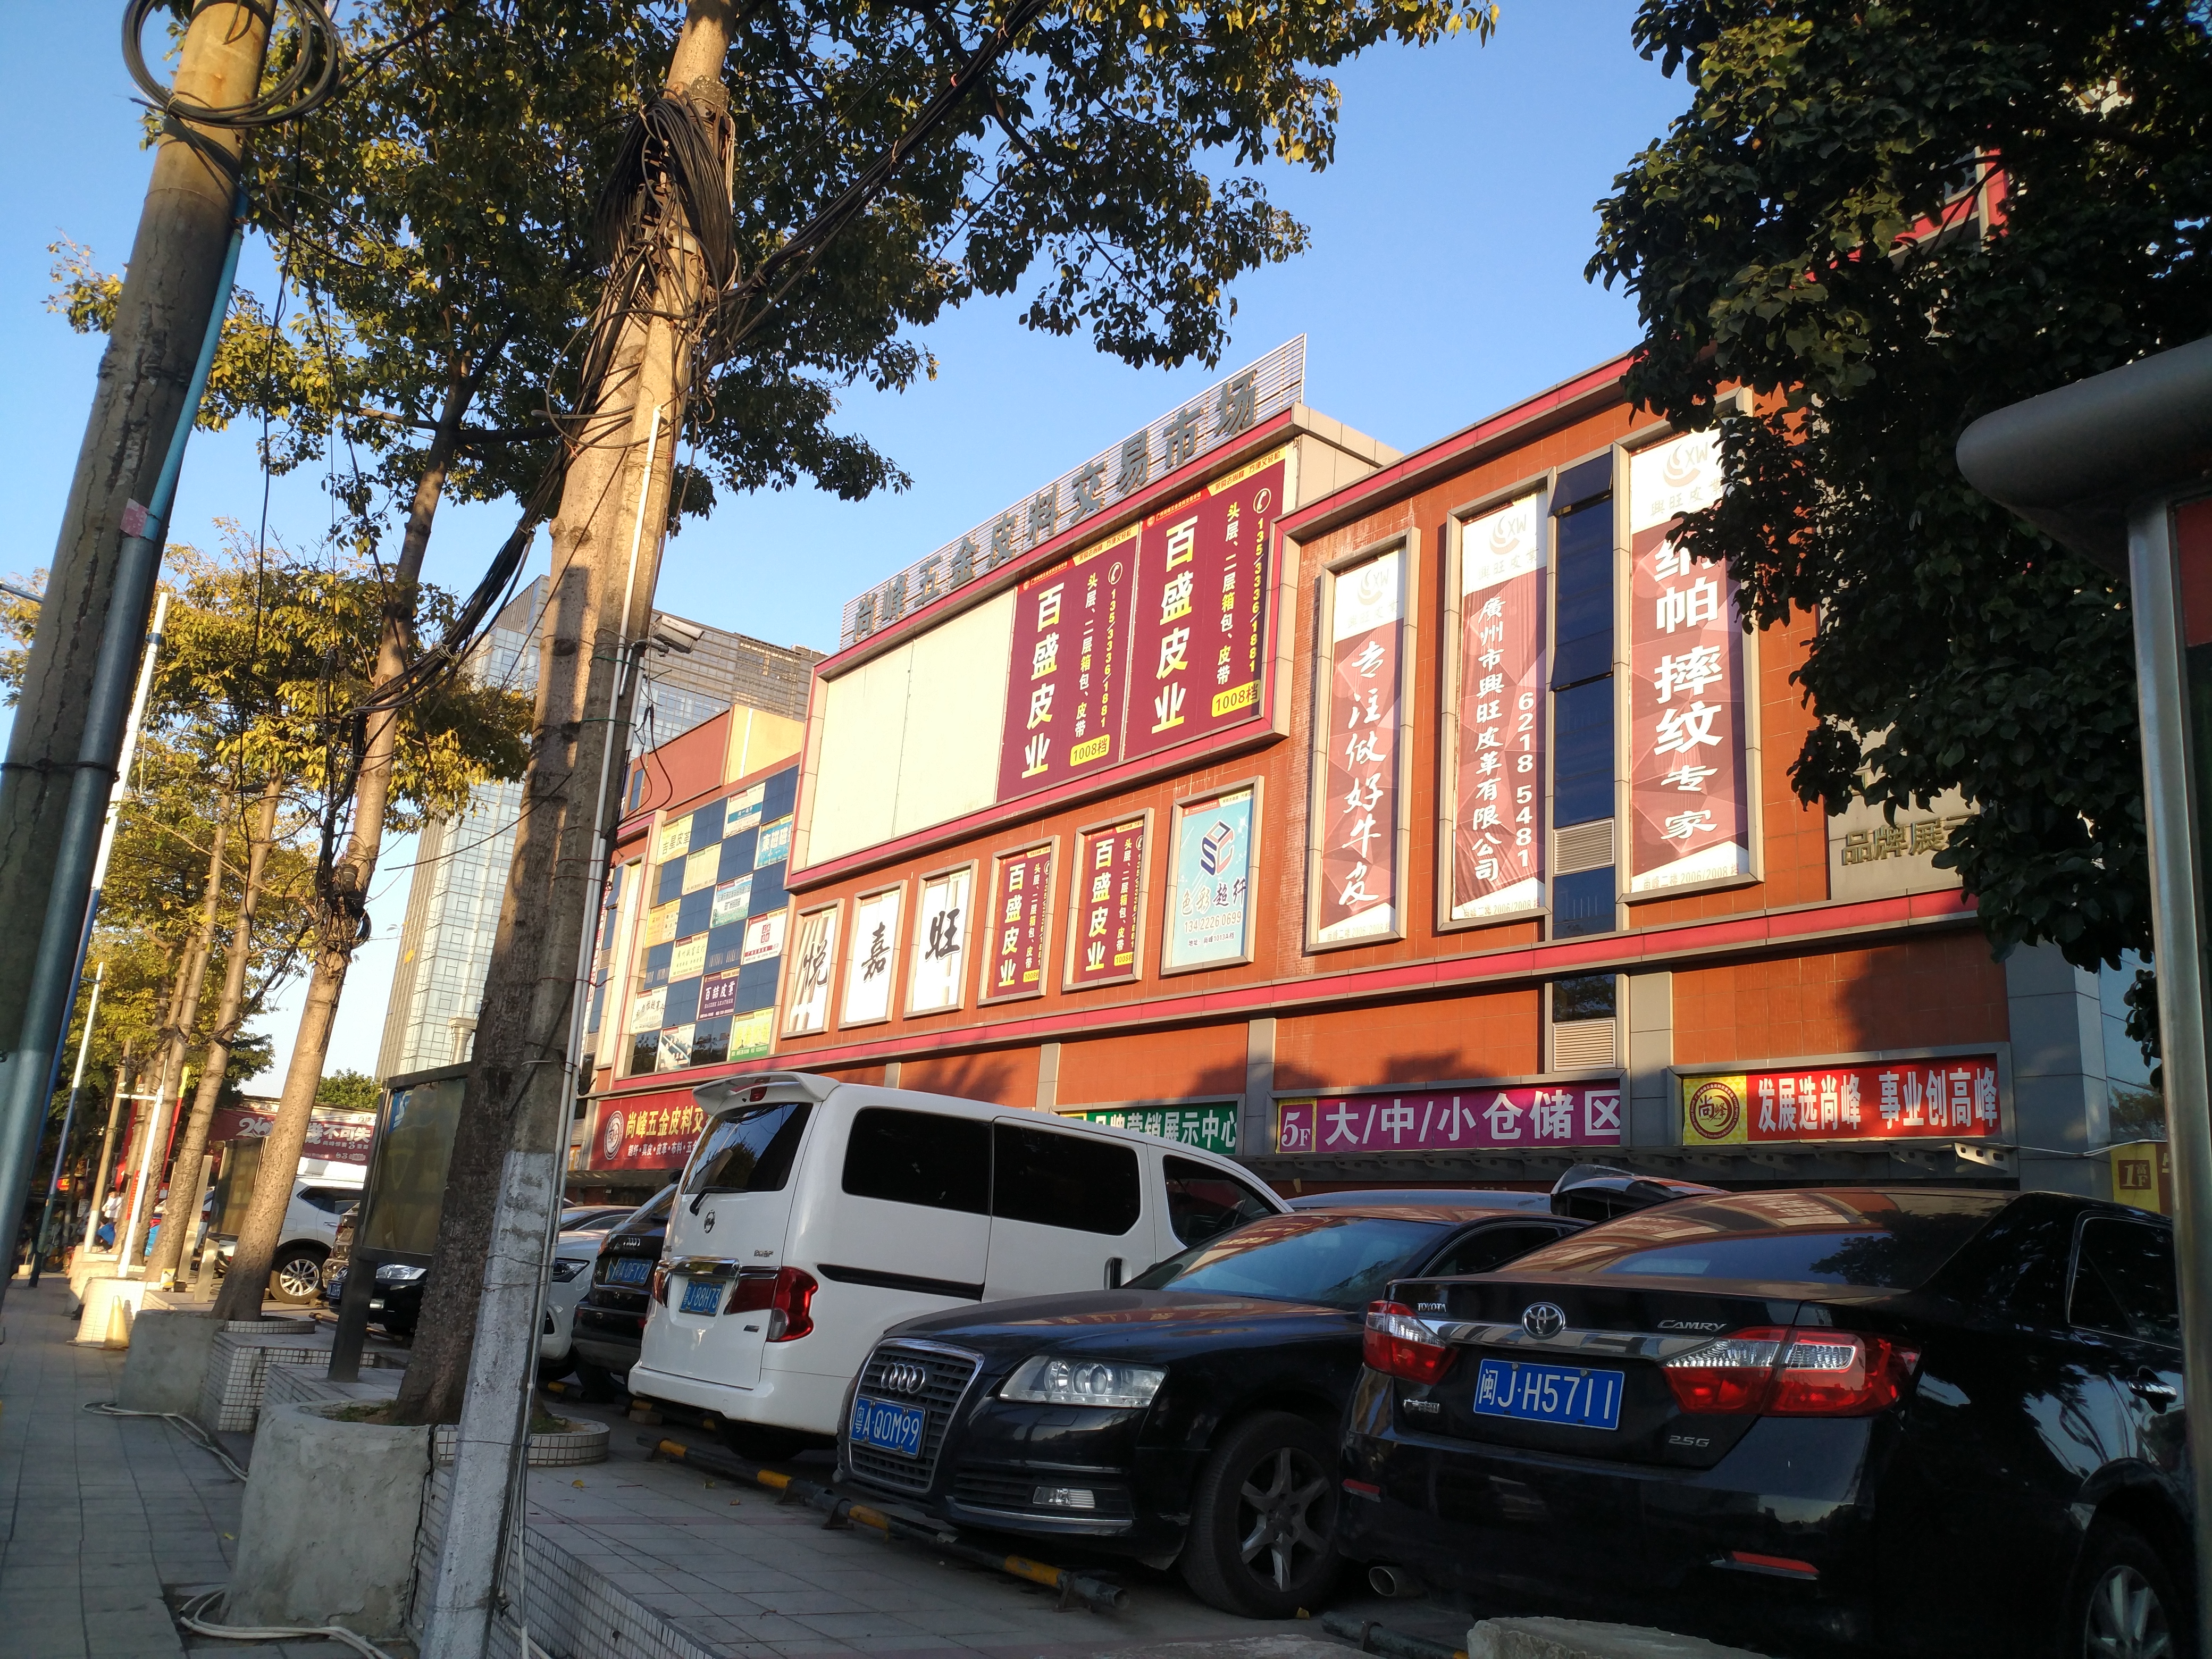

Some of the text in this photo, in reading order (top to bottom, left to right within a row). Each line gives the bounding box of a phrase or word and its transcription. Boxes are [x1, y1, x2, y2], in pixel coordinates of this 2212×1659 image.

[854, 370, 1258, 641] 尚峰五金皮料交易市场
[1151, 515, 1198, 734] 百盛皮业
[1021, 582, 1065, 778] 百盛皮业
[1215, 683, 1259, 712] 1008档
[1073, 738, 1108, 762] 1008档
[1515, 691, 1535, 868] 6218 5481
[662, 830, 691, 855] 吉星皮革
[1841, 812, 1975, 866] 品牌展
[999, 862, 1026, 987] 百盛皮业
[1085, 838, 1115, 971] 百盛皮业
[1185, 911, 1242, 933] 134 2226 0699
[625, 1105, 712, 1139] 尚峰五金皮料交
[1281, 1089, 1621, 1147] 5F 大/中/小仓储区
[1758, 1067, 1998, 1133] 发展选尚峰 事业创高峰
[1418, 1303, 1446, 1312] TOYOTA
[1657, 1319, 1727, 1332] CAMRY
